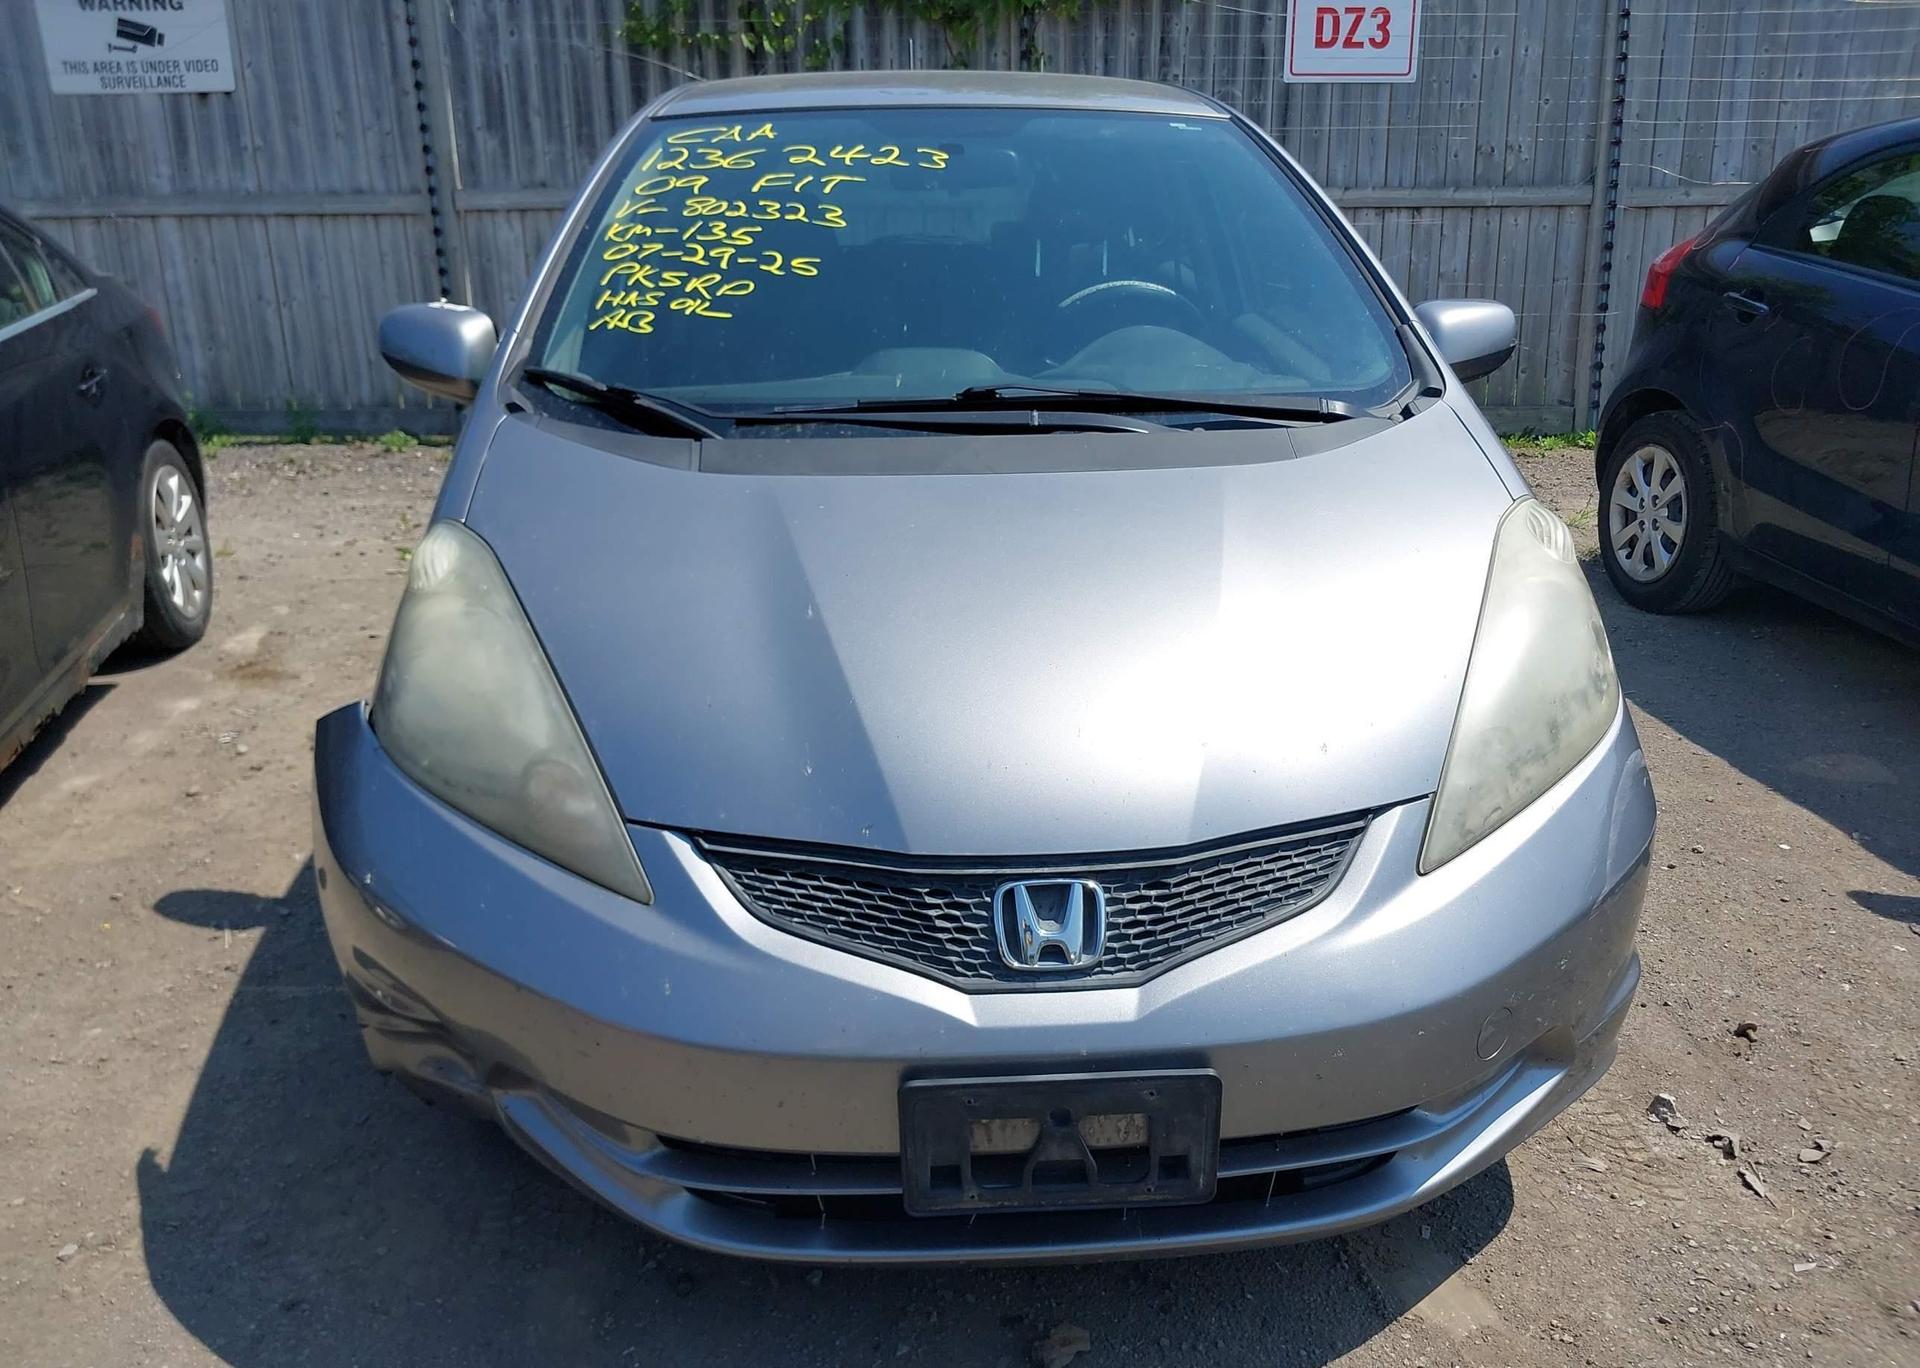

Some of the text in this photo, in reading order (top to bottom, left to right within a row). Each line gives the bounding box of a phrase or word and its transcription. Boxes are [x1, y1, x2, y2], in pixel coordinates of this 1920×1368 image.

[78, 0, 184, 11] WARNING
[1314, 7, 1391, 49] DZ3
[62, 59, 219, 75] THIS AREA IS UNDER VIDEO
[100, 75, 187, 90] SURVEILLANCE
[667, 122, 777, 144] CAA
[640, 144, 950, 172] 1236 2423
[634, 173, 867, 197] 09 FIT
[682, 197, 848, 228] 802323
